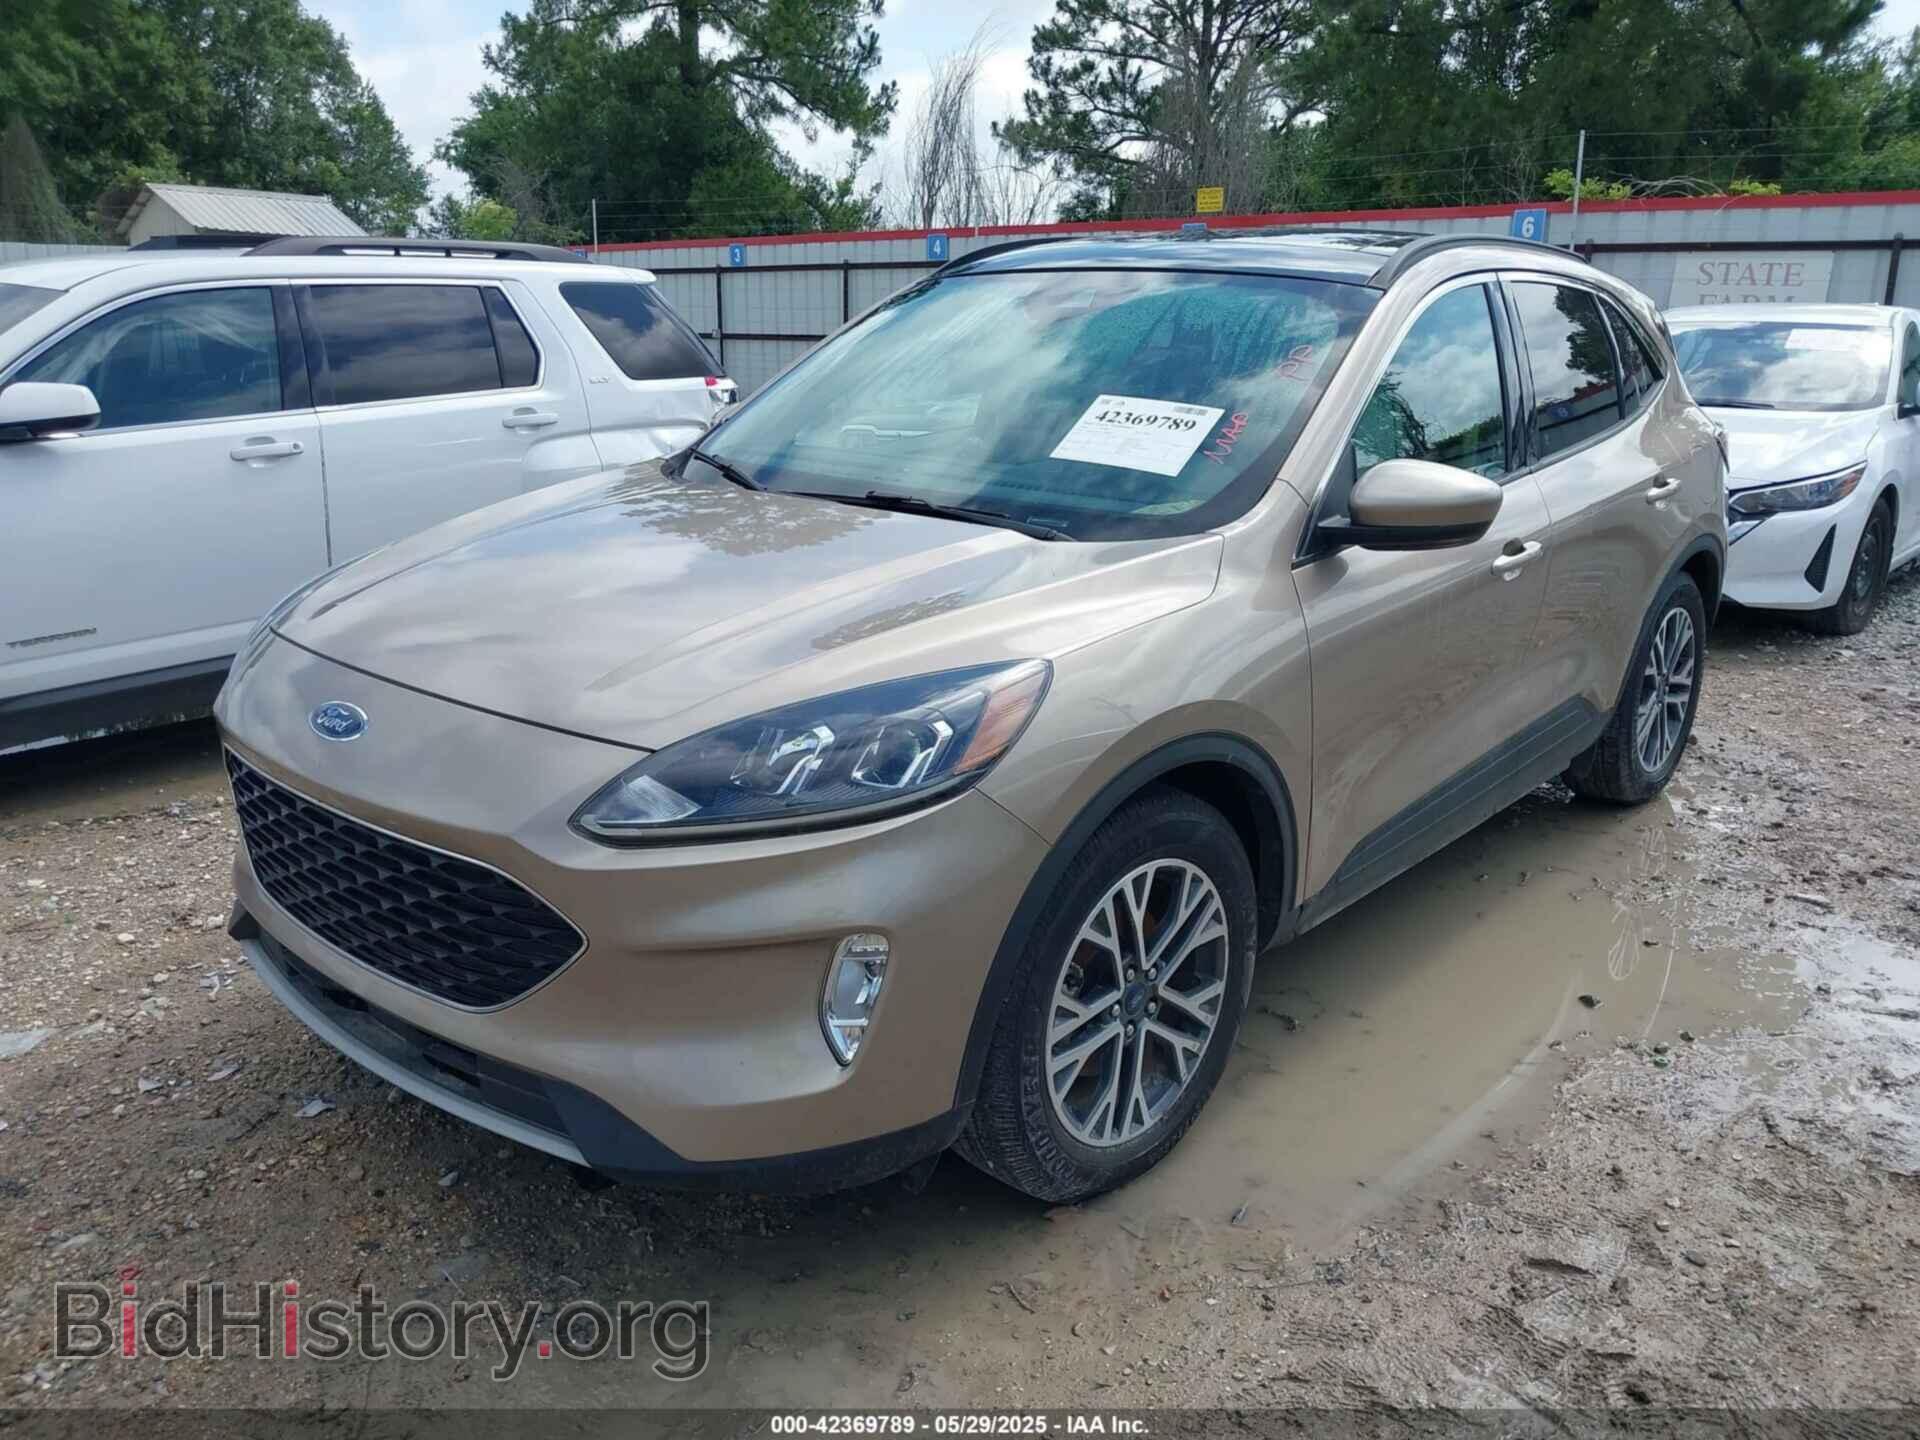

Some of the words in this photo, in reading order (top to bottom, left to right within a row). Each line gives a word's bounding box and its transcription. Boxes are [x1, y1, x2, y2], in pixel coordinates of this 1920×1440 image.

[1521, 216, 1535, 239] 6
[733, 247, 741, 263] 3
[933, 239, 942, 256] 4
[1697, 261, 1806, 287] STATE
[1096, 410, 1197, 432] 42369789
